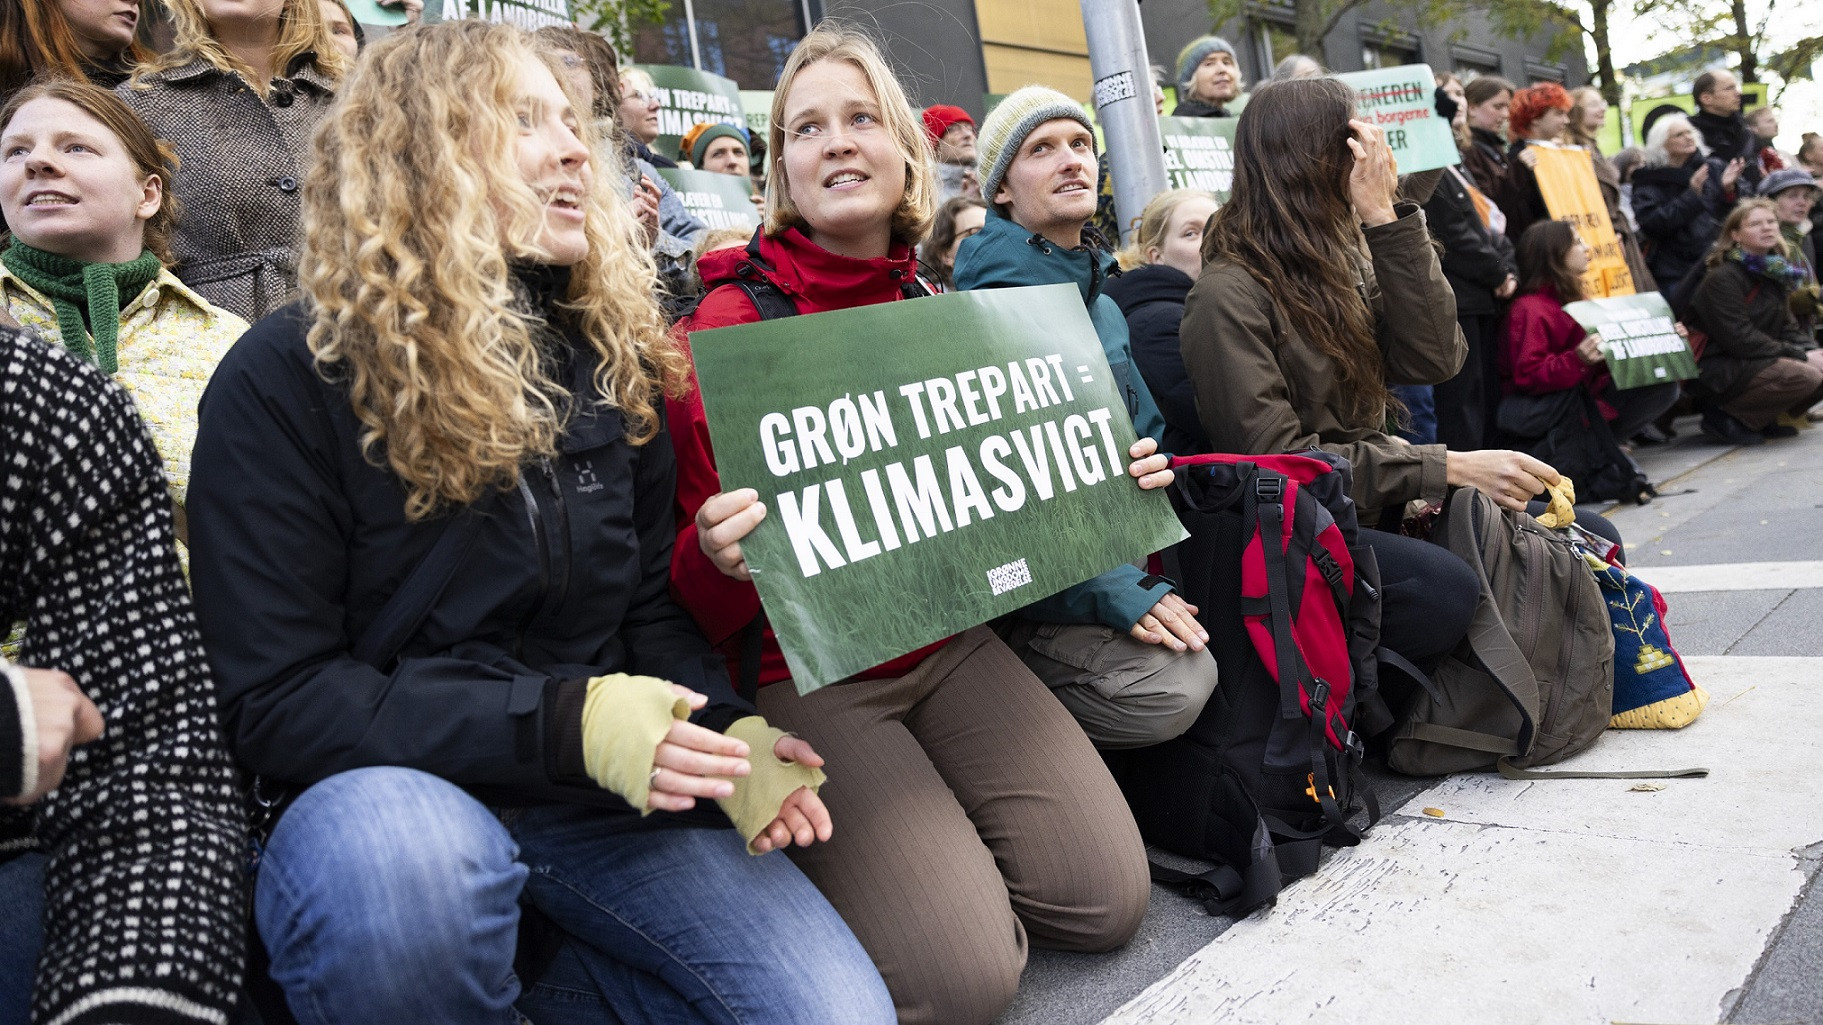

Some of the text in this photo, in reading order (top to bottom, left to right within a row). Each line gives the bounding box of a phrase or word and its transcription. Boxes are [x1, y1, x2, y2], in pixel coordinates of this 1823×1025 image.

[1387, 130, 1408, 151] ER
[760, 390, 898, 477] GRØN
[899, 353, 1074, 440] TREPART
[776, 407, 1124, 578] KLIMASVIGT
